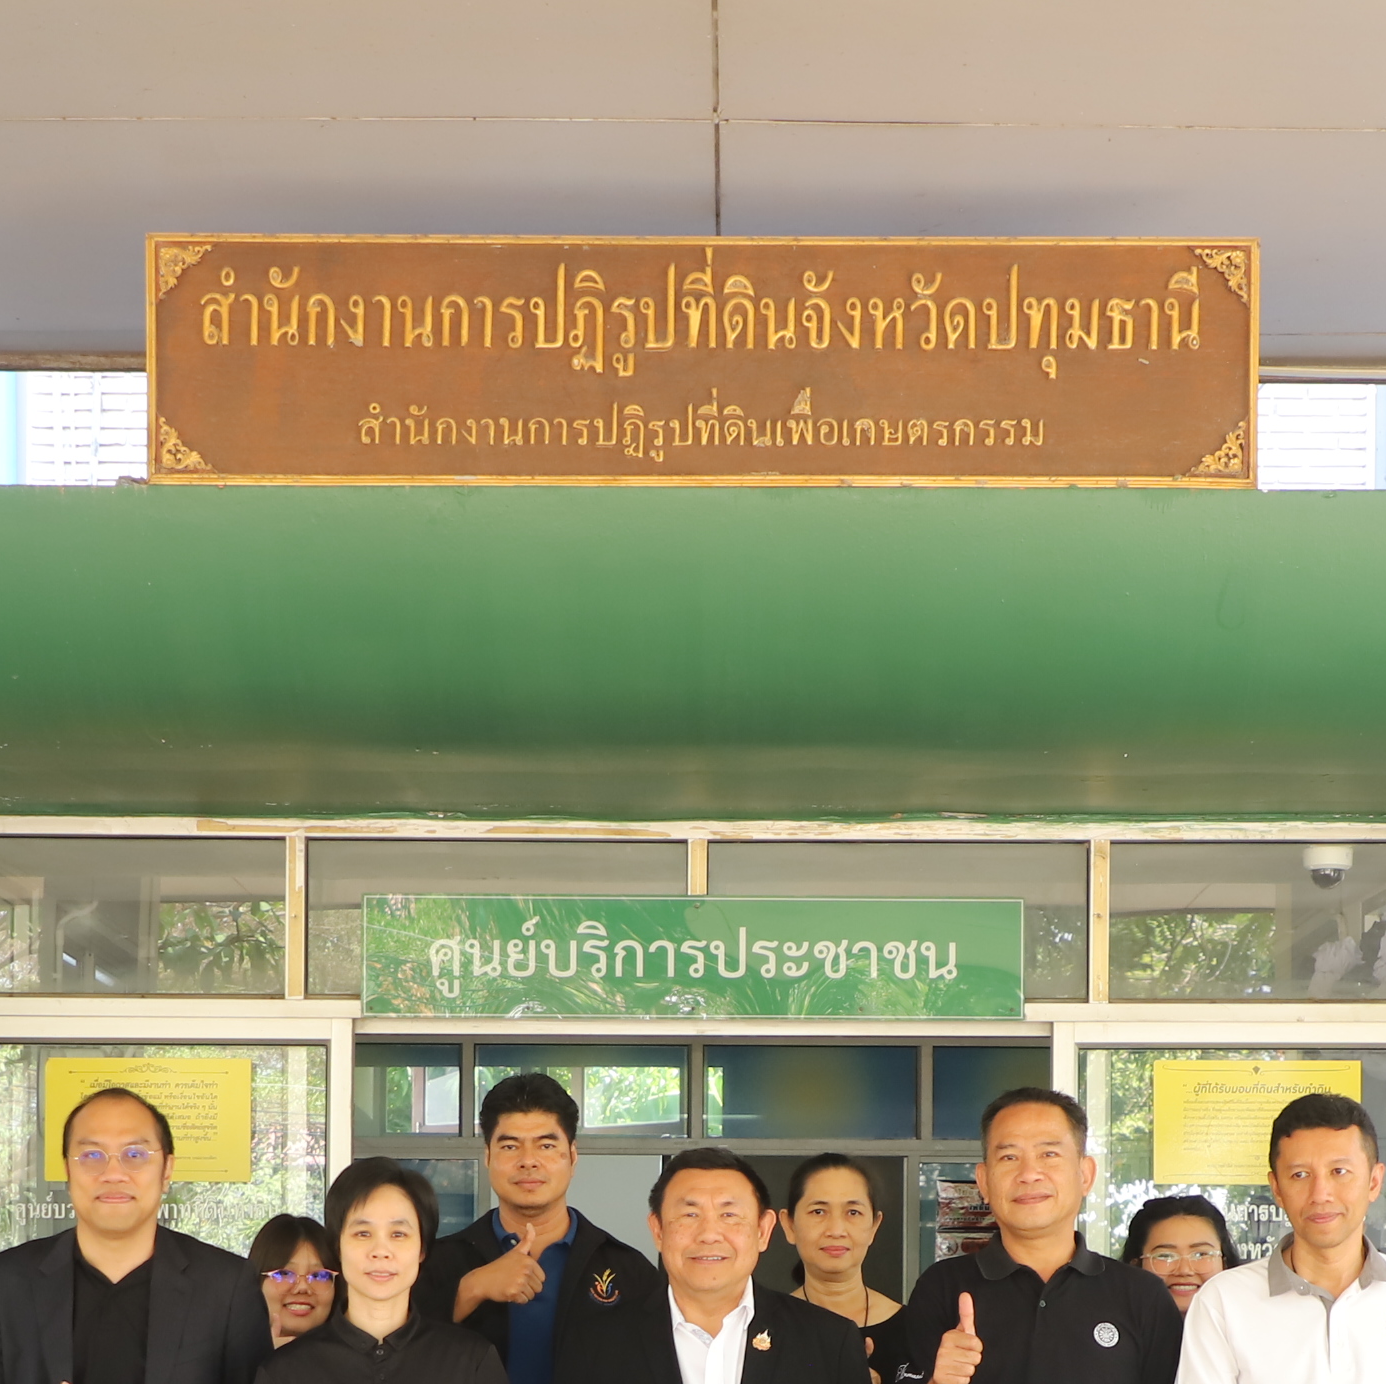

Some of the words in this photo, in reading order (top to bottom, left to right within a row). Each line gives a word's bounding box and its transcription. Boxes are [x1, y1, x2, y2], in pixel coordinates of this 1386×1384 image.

[200, 248, 1200, 380] สำนักงานการปฏิรูปที่ดินจังหวัดปทุมธานี
[358, 387, 1044, 462] สำนักงานการปฏิรูปที่ดินเพื่อเกษตรกรรม
[428, 916, 958, 999] ศูนย์บริการประชาชน
